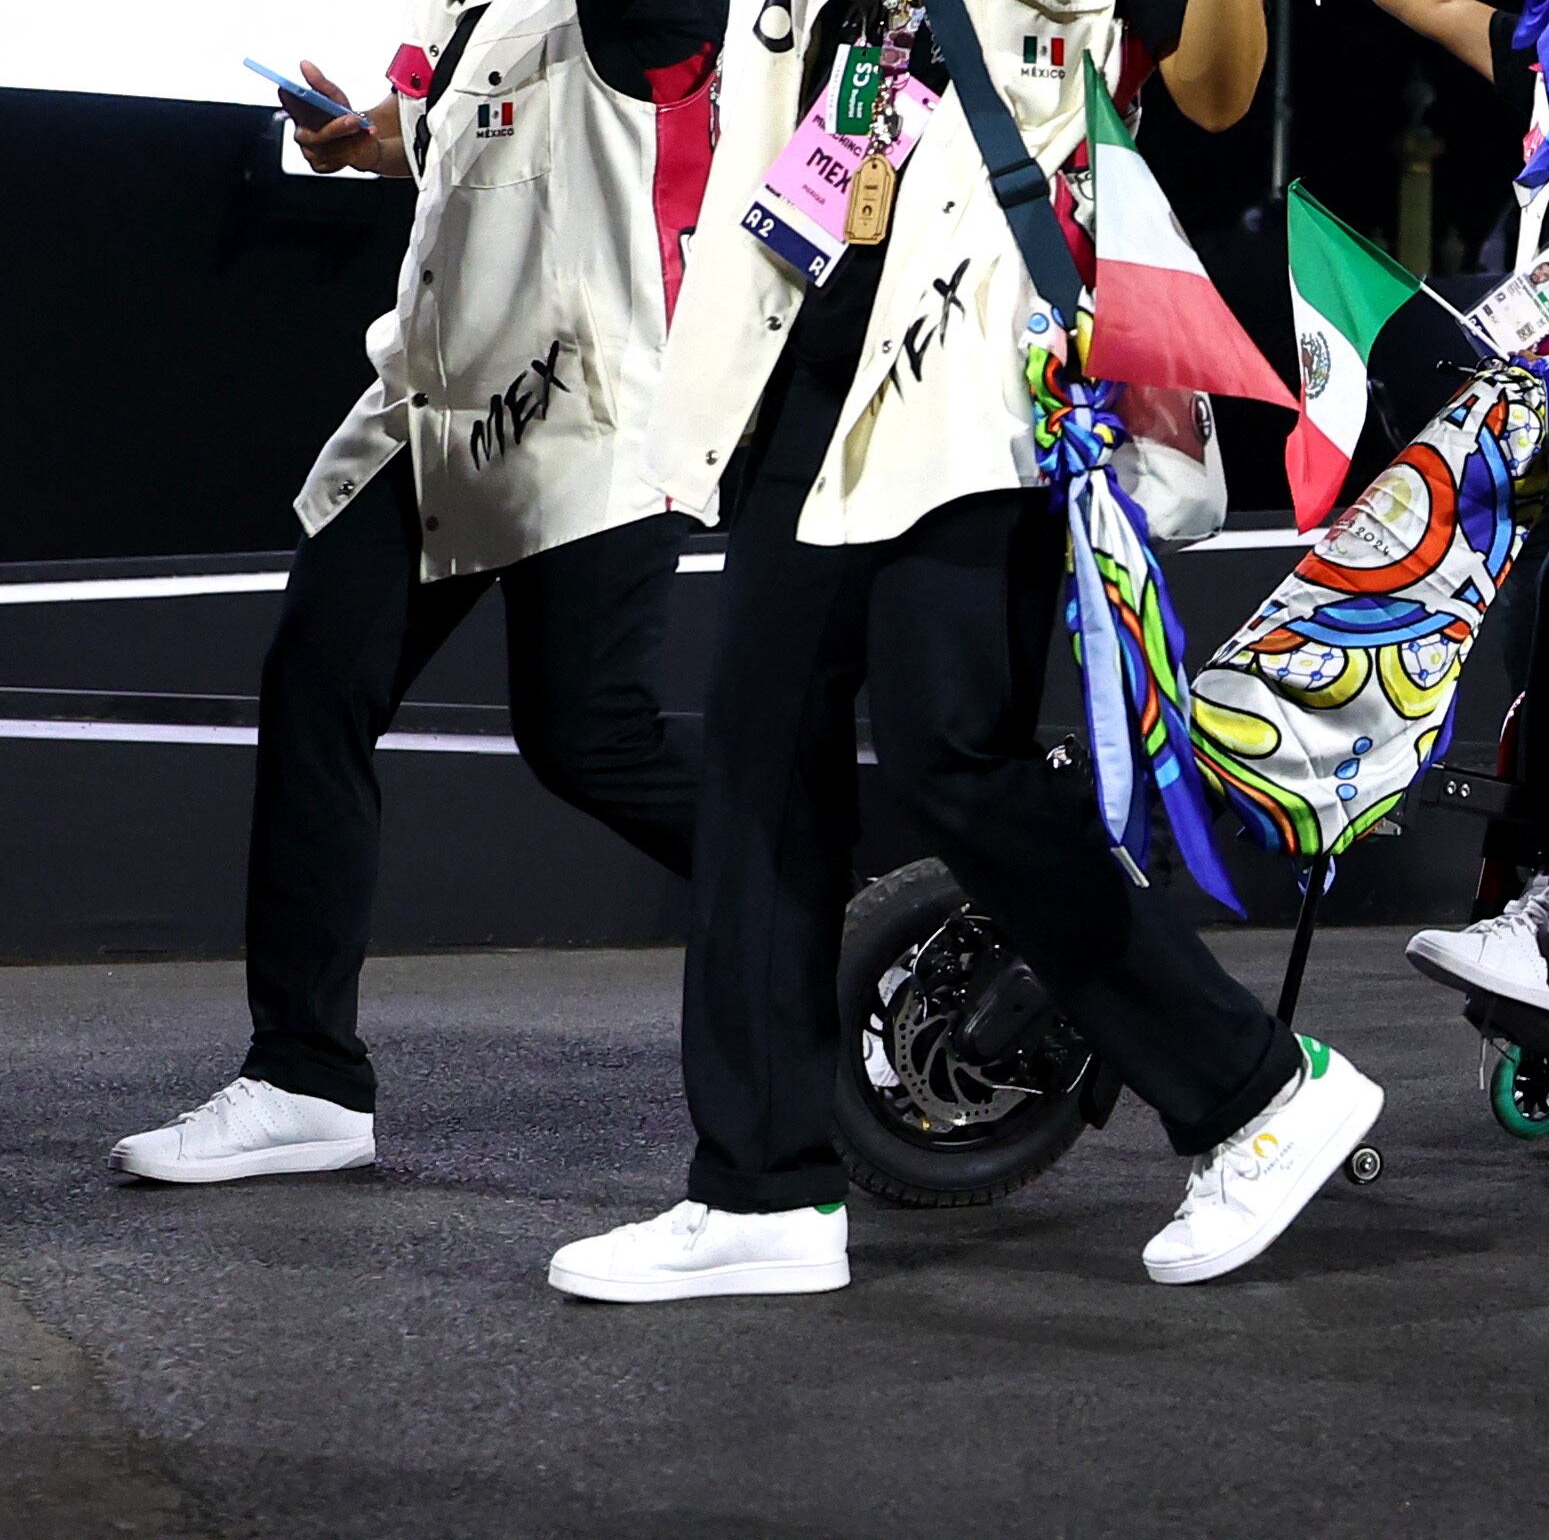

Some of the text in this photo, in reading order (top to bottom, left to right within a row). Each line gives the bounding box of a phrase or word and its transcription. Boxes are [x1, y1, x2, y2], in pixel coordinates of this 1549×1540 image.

[1021, 66, 1066, 80] MÉXICO
[806, 147, 853, 195] MEX
[808, 256, 825, 277] R
[470, 340, 571, 472] MEX
[1355, 526, 1390, 557] 2024
